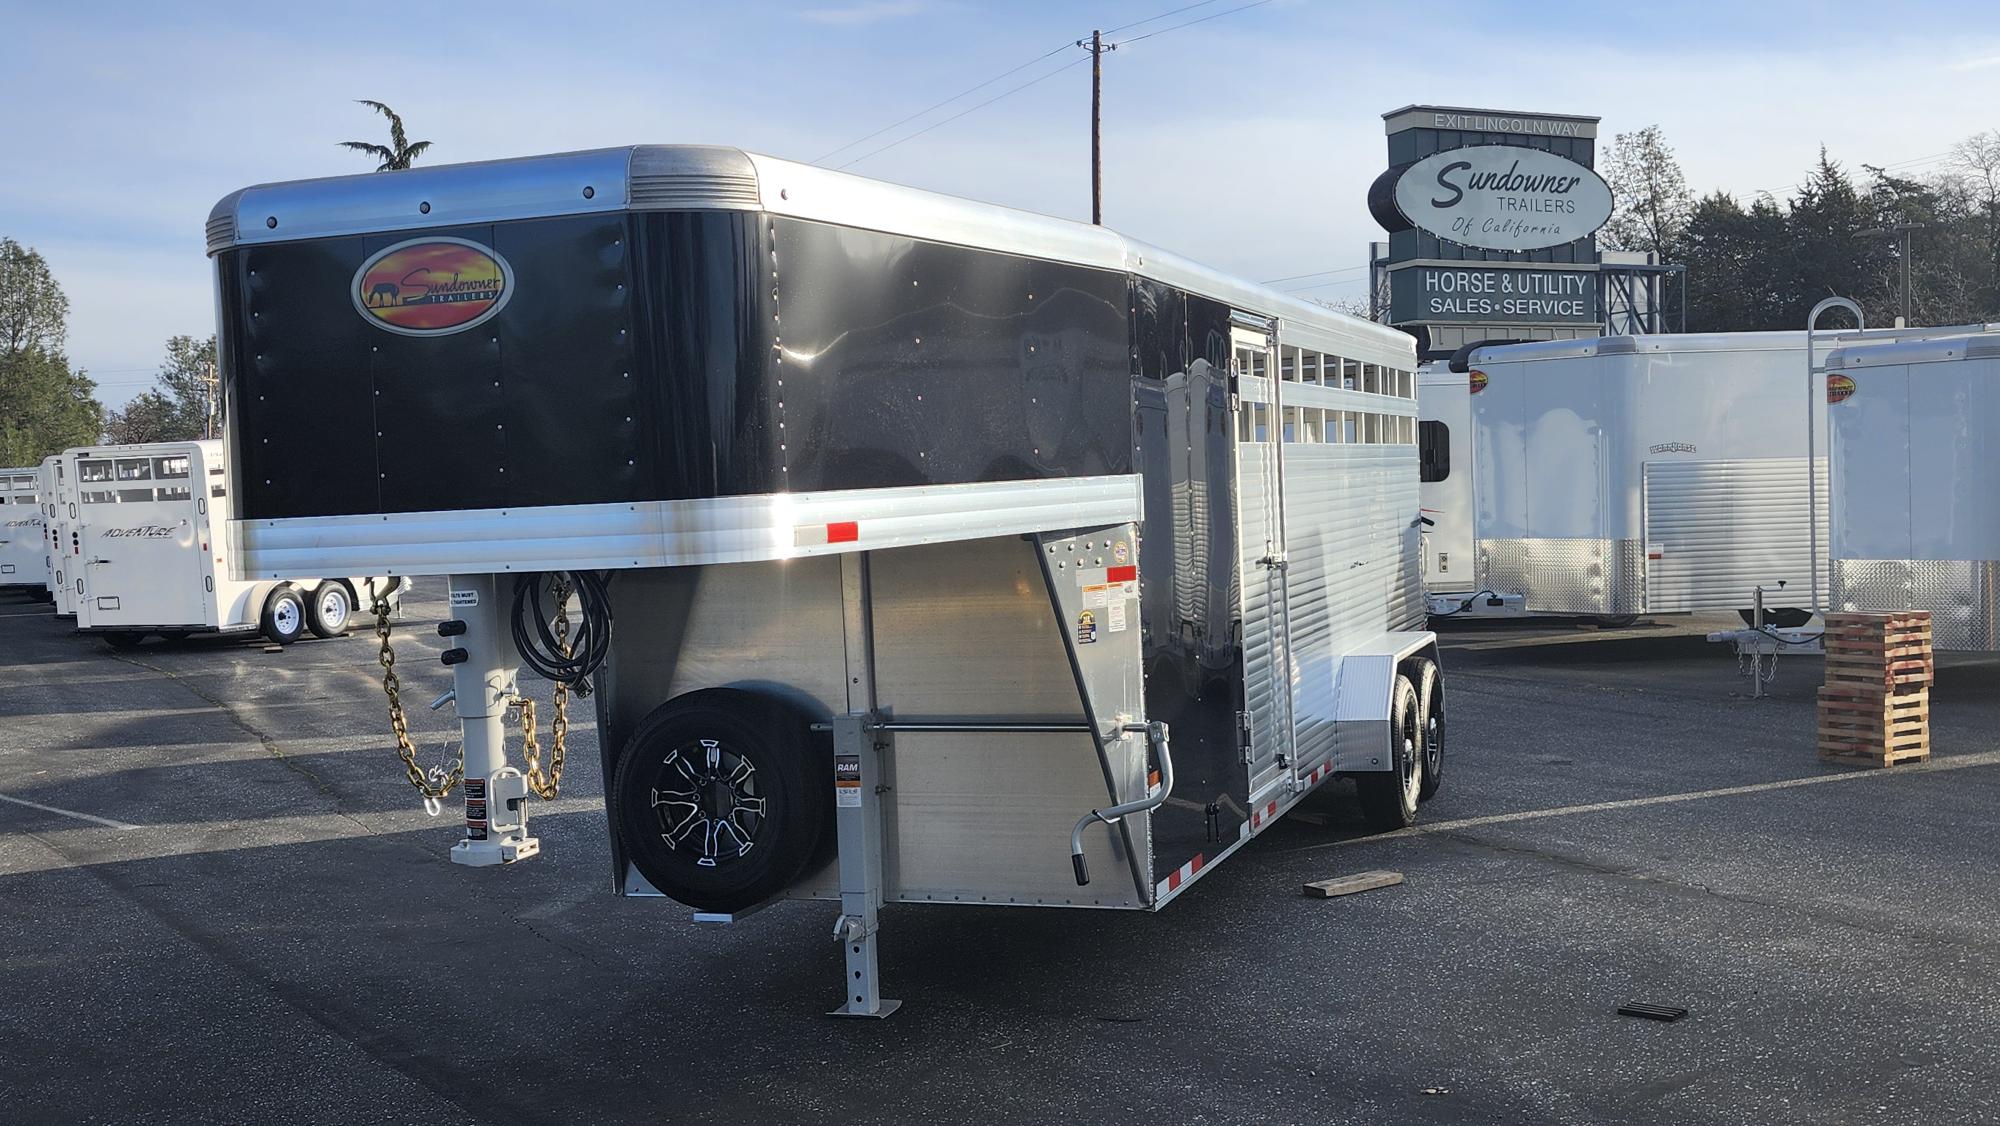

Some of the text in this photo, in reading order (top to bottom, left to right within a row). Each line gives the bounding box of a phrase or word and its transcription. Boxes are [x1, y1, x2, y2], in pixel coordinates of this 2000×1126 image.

[1434, 113, 1581, 137] EXIT LINCOLN WAY
[1431, 160, 1581, 208] Sundowner
[1497, 196, 1576, 214] TRAILERS
[1451, 216, 1560, 238] Of California
[401, 267, 501, 298] Sundowner
[1425, 271, 1587, 295] HORSE & UTILITY
[432, 291, 493, 303] TRAILERS
[1430, 297, 1585, 315] SALES SERVICE
[100, 525, 177, 537] ADVENTURE
[837, 763, 858, 771] RAM
